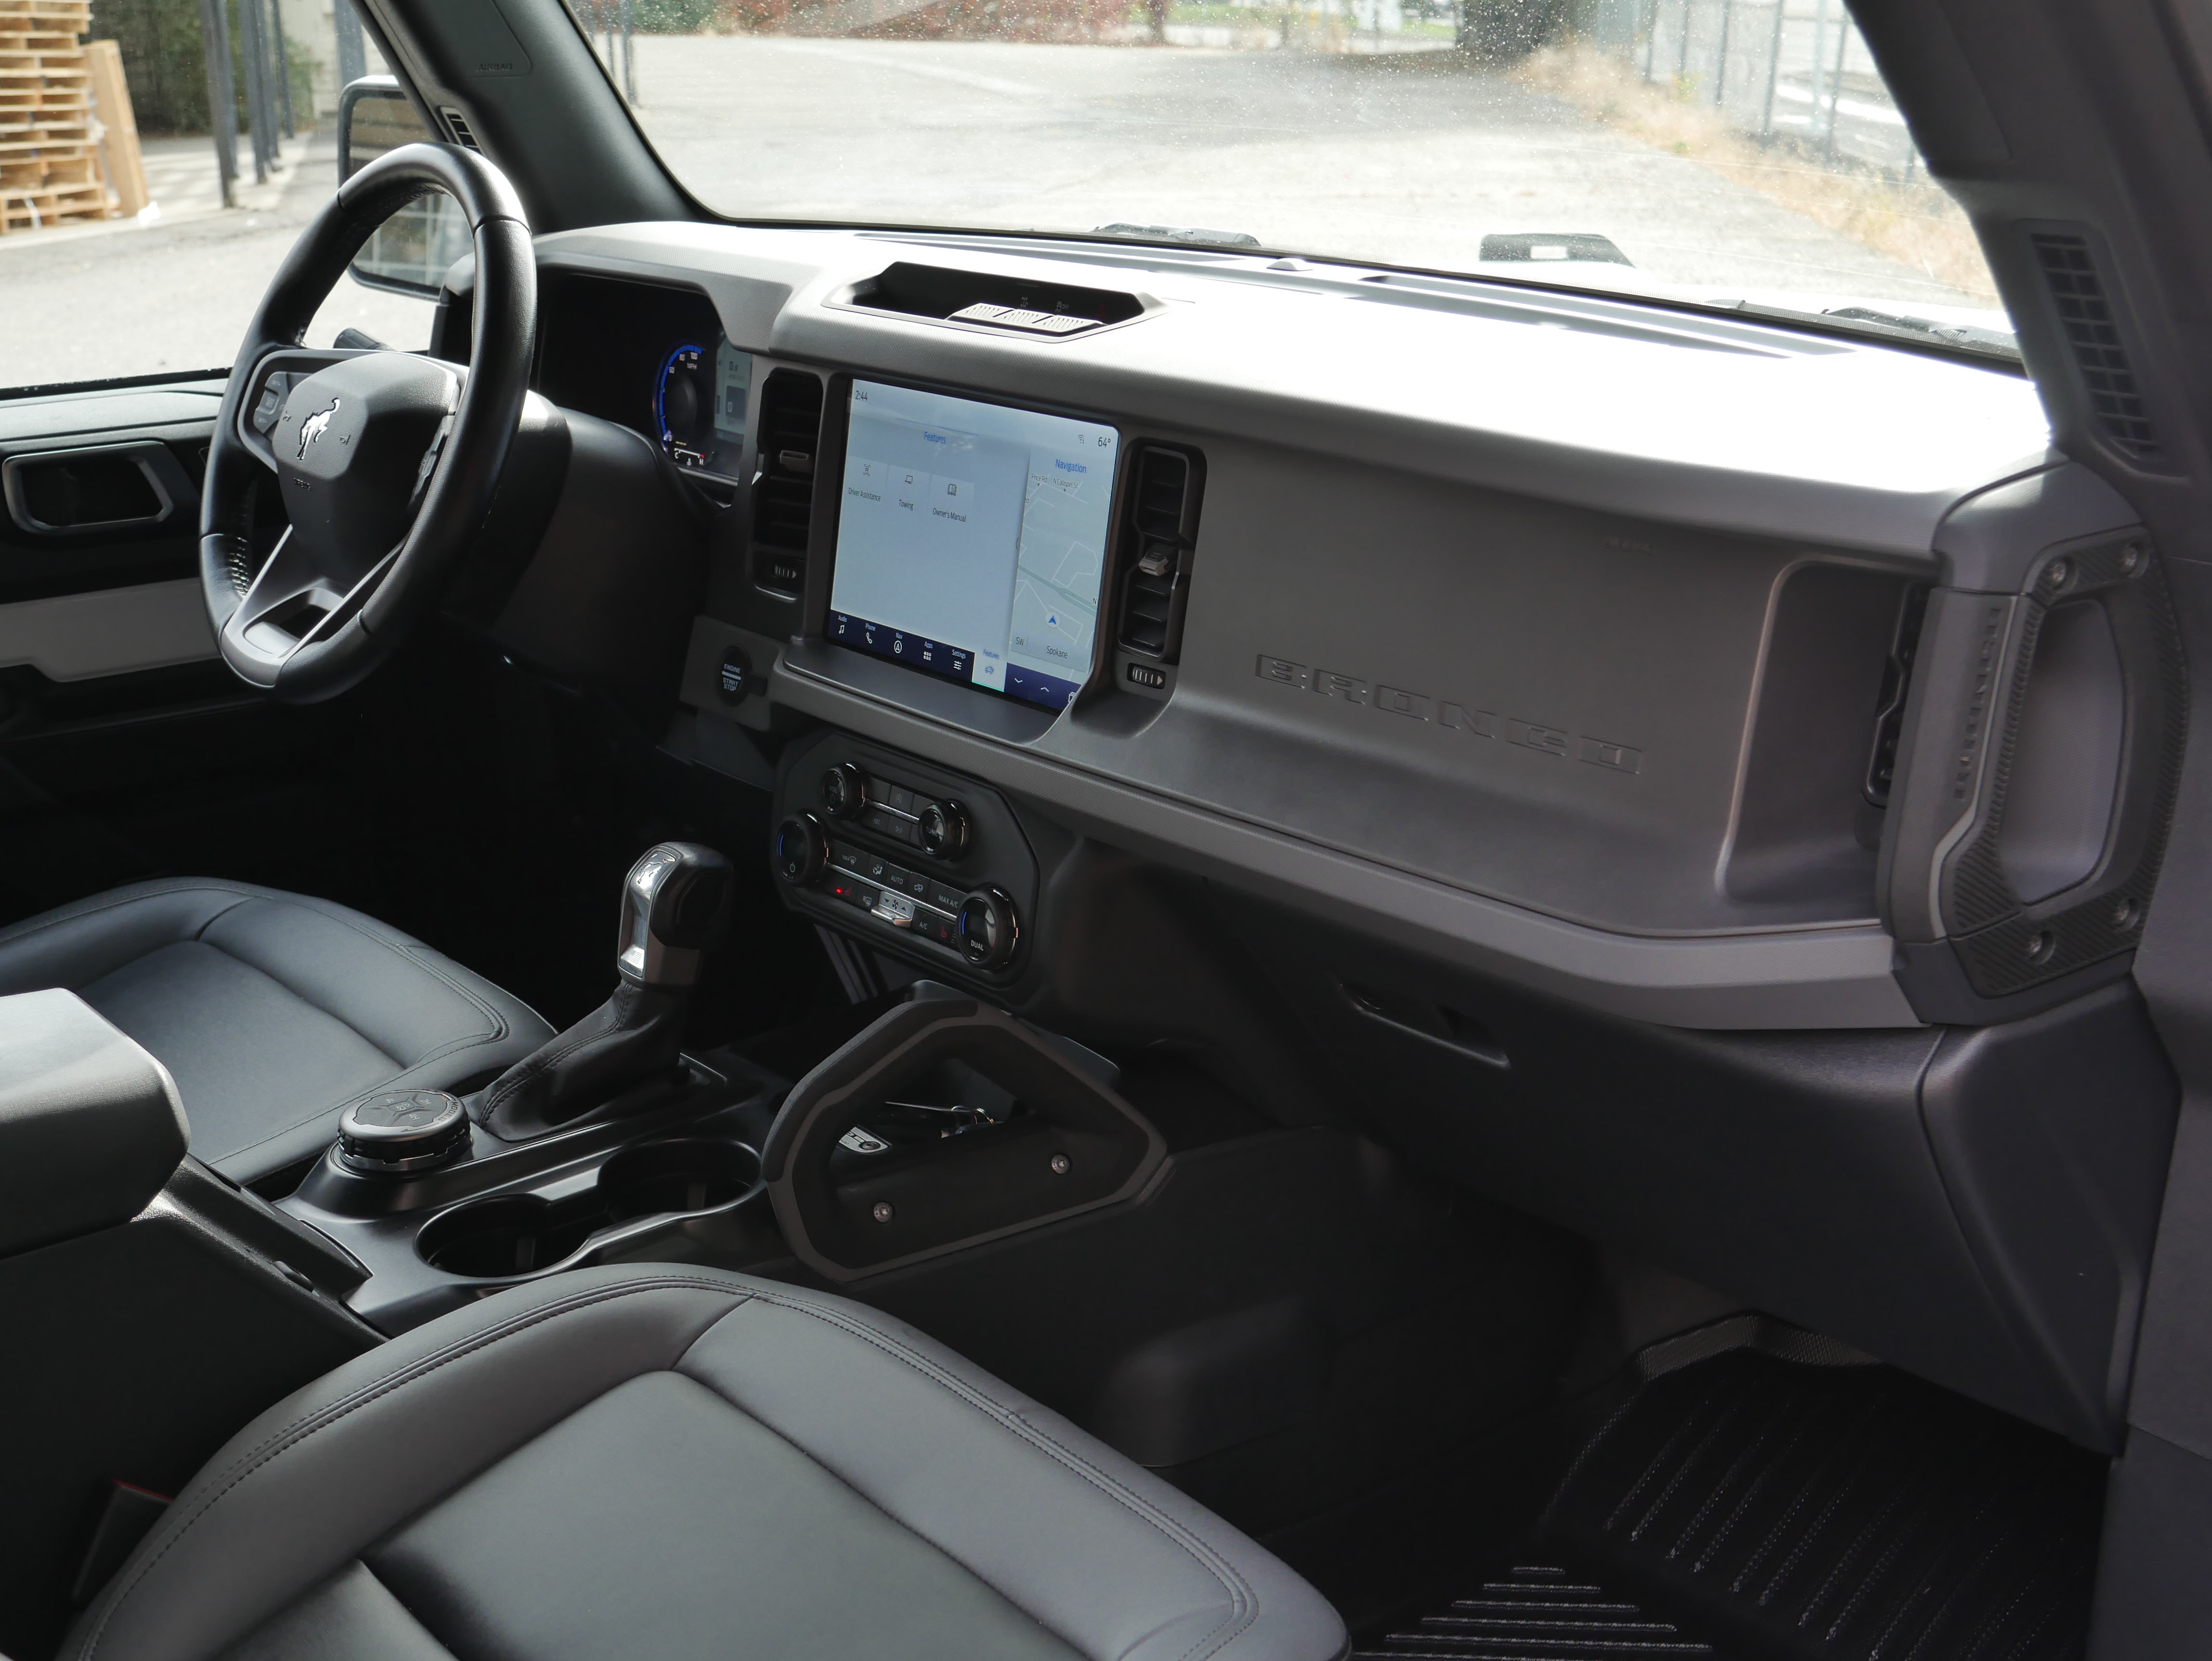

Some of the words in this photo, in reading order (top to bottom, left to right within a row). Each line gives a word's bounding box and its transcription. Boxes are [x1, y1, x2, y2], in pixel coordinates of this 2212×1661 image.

[477, 63, 513, 71] AIRBAG
[855, 391, 868, 402] 2:44
[924, 431, 946, 445] Features
[1098, 436, 1111, 448] 64°
[1055, 459, 1087, 474] Navigation
[1031, 473, 1042, 482] Price
[1057, 478, 1073, 488] Calispel
[848, 487, 860, 498] Driver
[860, 490, 882, 502] Assistance
[899, 499, 914, 511] Towing
[933, 507, 950, 519] Owner's
[951, 510, 967, 523] Manual
[838, 614, 847, 622] Audio
[865, 623, 876, 632] Phone
[924, 641, 933, 649] Apps
[1015, 636, 1025, 646] SW
[951, 649, 966, 659] Settings
[983, 648, 1000, 660] Features
[1046, 644, 1068, 659] Spokane
[724, 663, 740, 673] ENGINE
[723, 677, 738, 686] START
[724, 683, 737, 691] STOP
[1254, 653, 1644, 775] BRONCO
[925, 826, 937, 837] TUNE
[890, 874, 904, 885] AUTO
[938, 895, 949, 905] MAX
[949, 899, 960, 909] A/C
[919, 921, 928, 930] A/C
[970, 940, 985, 951] DUAL
[437, 1101, 458, 1123] MODES
